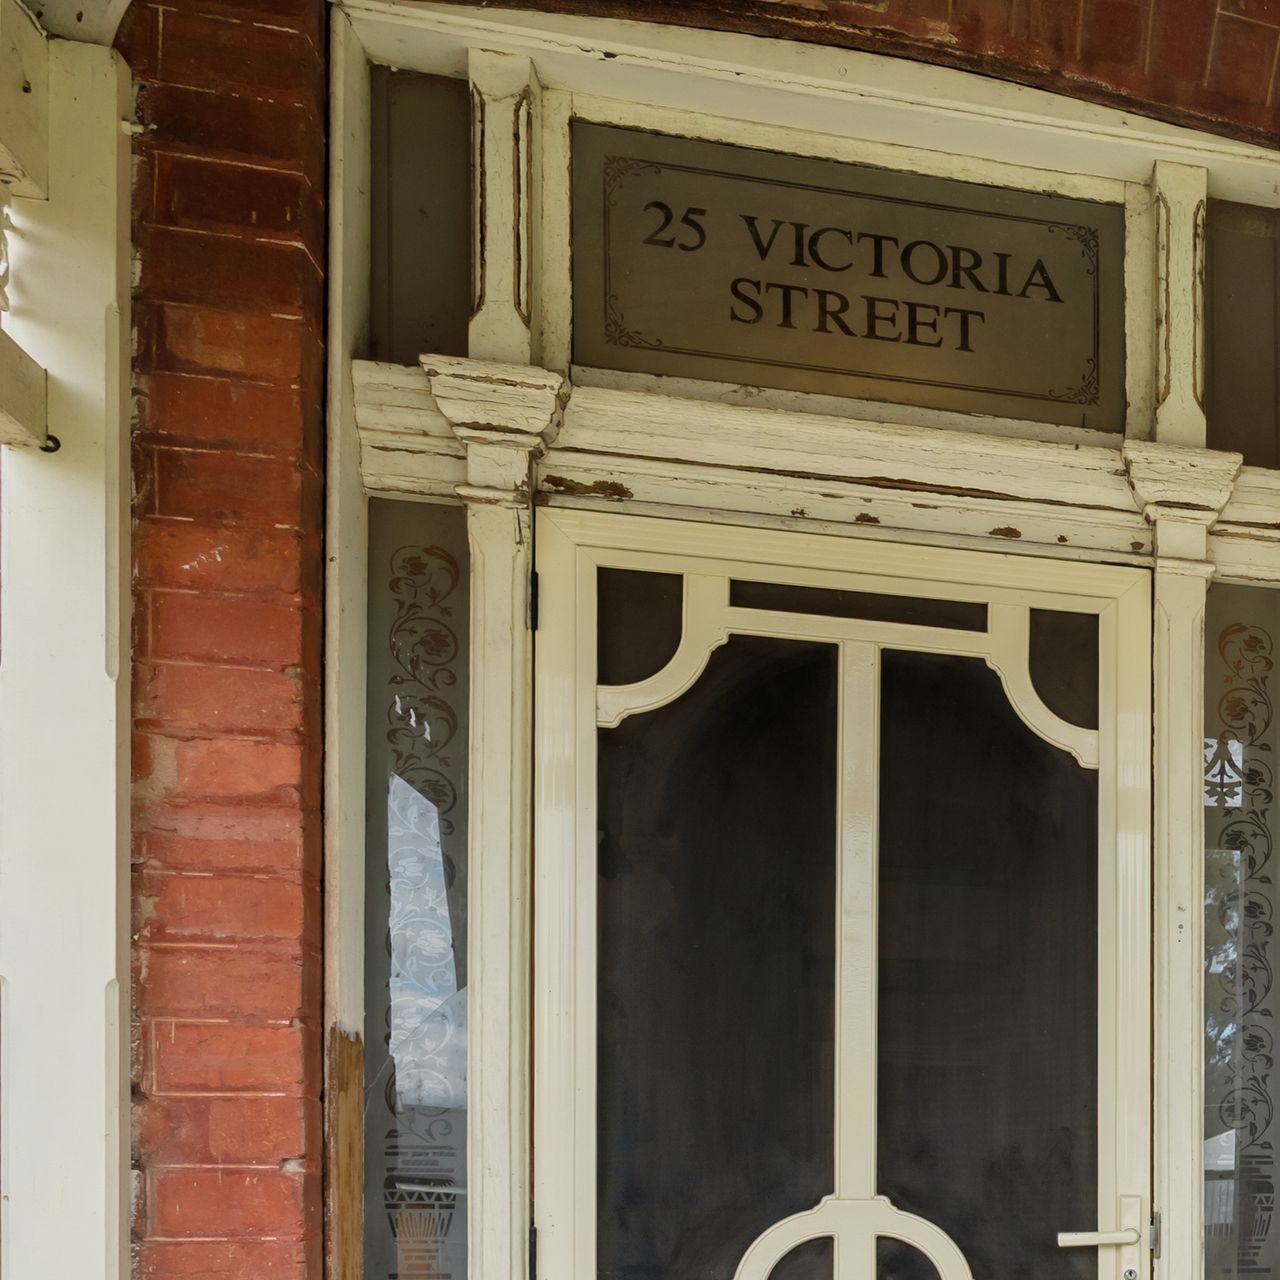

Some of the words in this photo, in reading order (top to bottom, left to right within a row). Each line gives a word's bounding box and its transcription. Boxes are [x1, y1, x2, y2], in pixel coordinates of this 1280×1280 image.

[642, 201, 707, 252] 25
[739, 214, 1065, 303] VICTORIA
[729, 278, 985, 352] STREET
